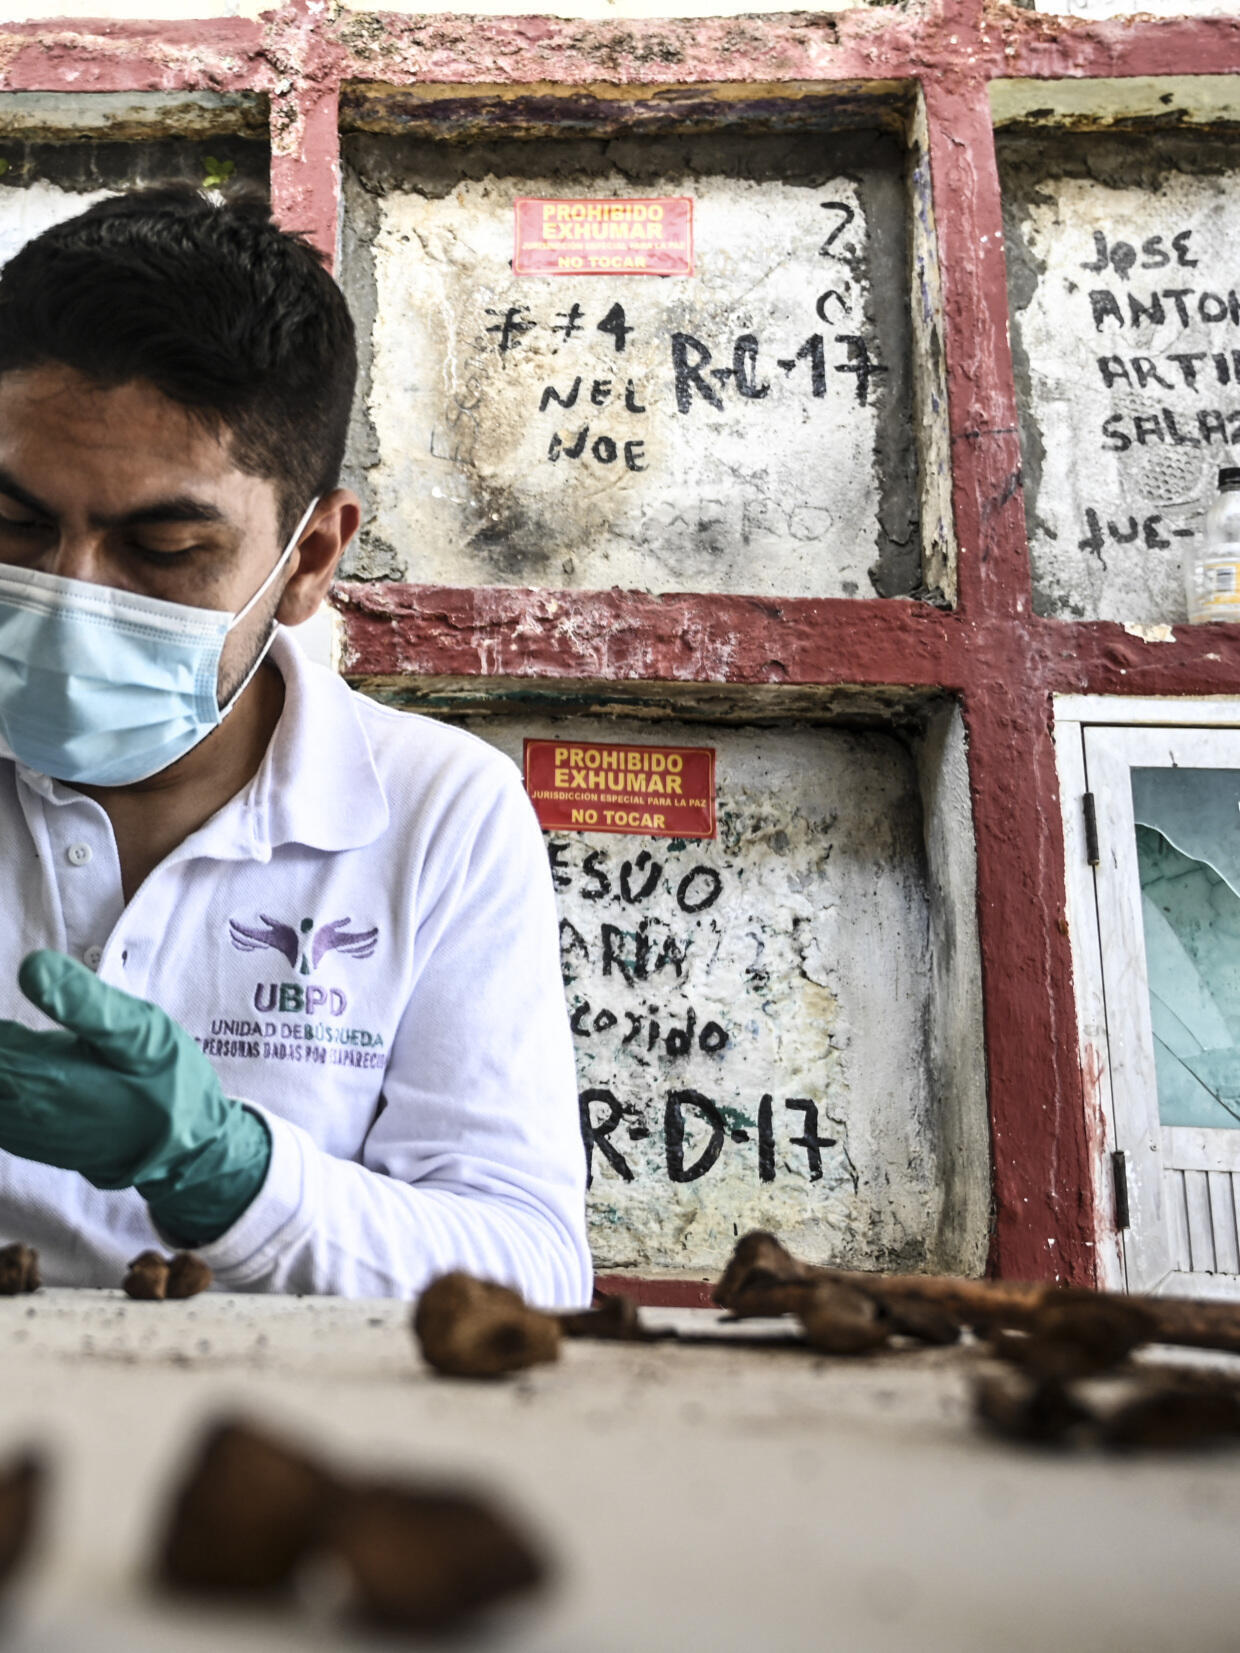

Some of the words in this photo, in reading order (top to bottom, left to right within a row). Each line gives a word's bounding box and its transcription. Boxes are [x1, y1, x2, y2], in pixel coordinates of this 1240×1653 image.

[542, 204, 664, 221] PROHIBIDO
[542, 222, 663, 240] EXHUMAR
[558, 256, 583, 268] NO
[587, 256, 647, 268] TOCAR
[1080, 230, 1199, 275] JOSE
[539, 376, 646, 413] NEL
[548, 424, 650, 472] NOE
[554, 748, 683, 773] PROHIBIDO
[554, 768, 683, 794] EXHUMAR
[601, 793, 645, 805] ESPECIAL
[648, 797, 672, 807] PARA
[674, 799, 687, 808] LA
[689, 799, 707, 808] PAZ
[571, 808, 598, 825] NO
[603, 810, 666, 829] TOCAR
[253, 982, 347, 1017] UBPD
[211, 1019, 276, 1038] UNIDAD
[280, 1022, 304, 1039] DE
